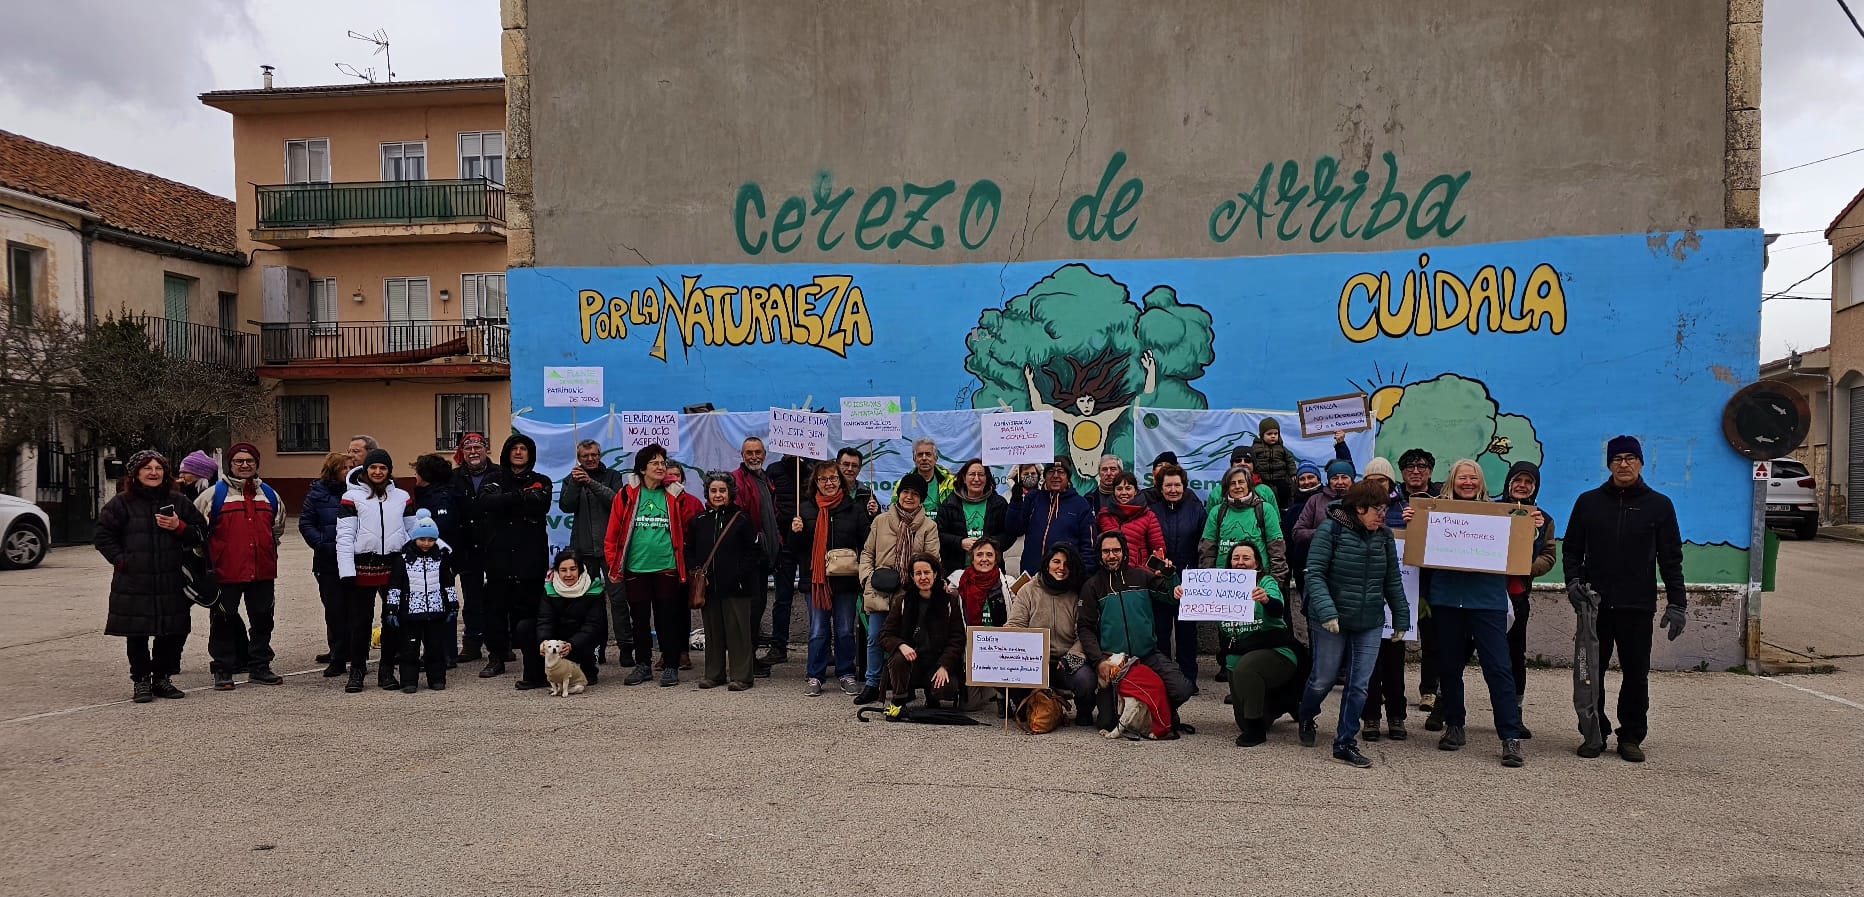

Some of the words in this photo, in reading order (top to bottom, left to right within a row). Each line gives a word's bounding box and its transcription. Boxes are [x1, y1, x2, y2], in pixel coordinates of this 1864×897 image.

[1067, 151, 1144, 243] de
[1208, 152, 1472, 243] Arriba
[578, 289, 629, 344] POR
[629, 287, 661, 326] LA
[649, 274, 874, 365] NATURALEZA
[623, 414, 632, 423] EL
[654, 414, 676, 424] MATA
[628, 426, 639, 435] NO
[640, 426, 650, 436] AL
[772, 424, 784, 436] YA
[1430, 516, 1441, 524] LA
[1188, 571, 1212, 583] PICO
[1216, 571, 1247, 584] LOBO
[1215, 588, 1252, 601] NATURAL
